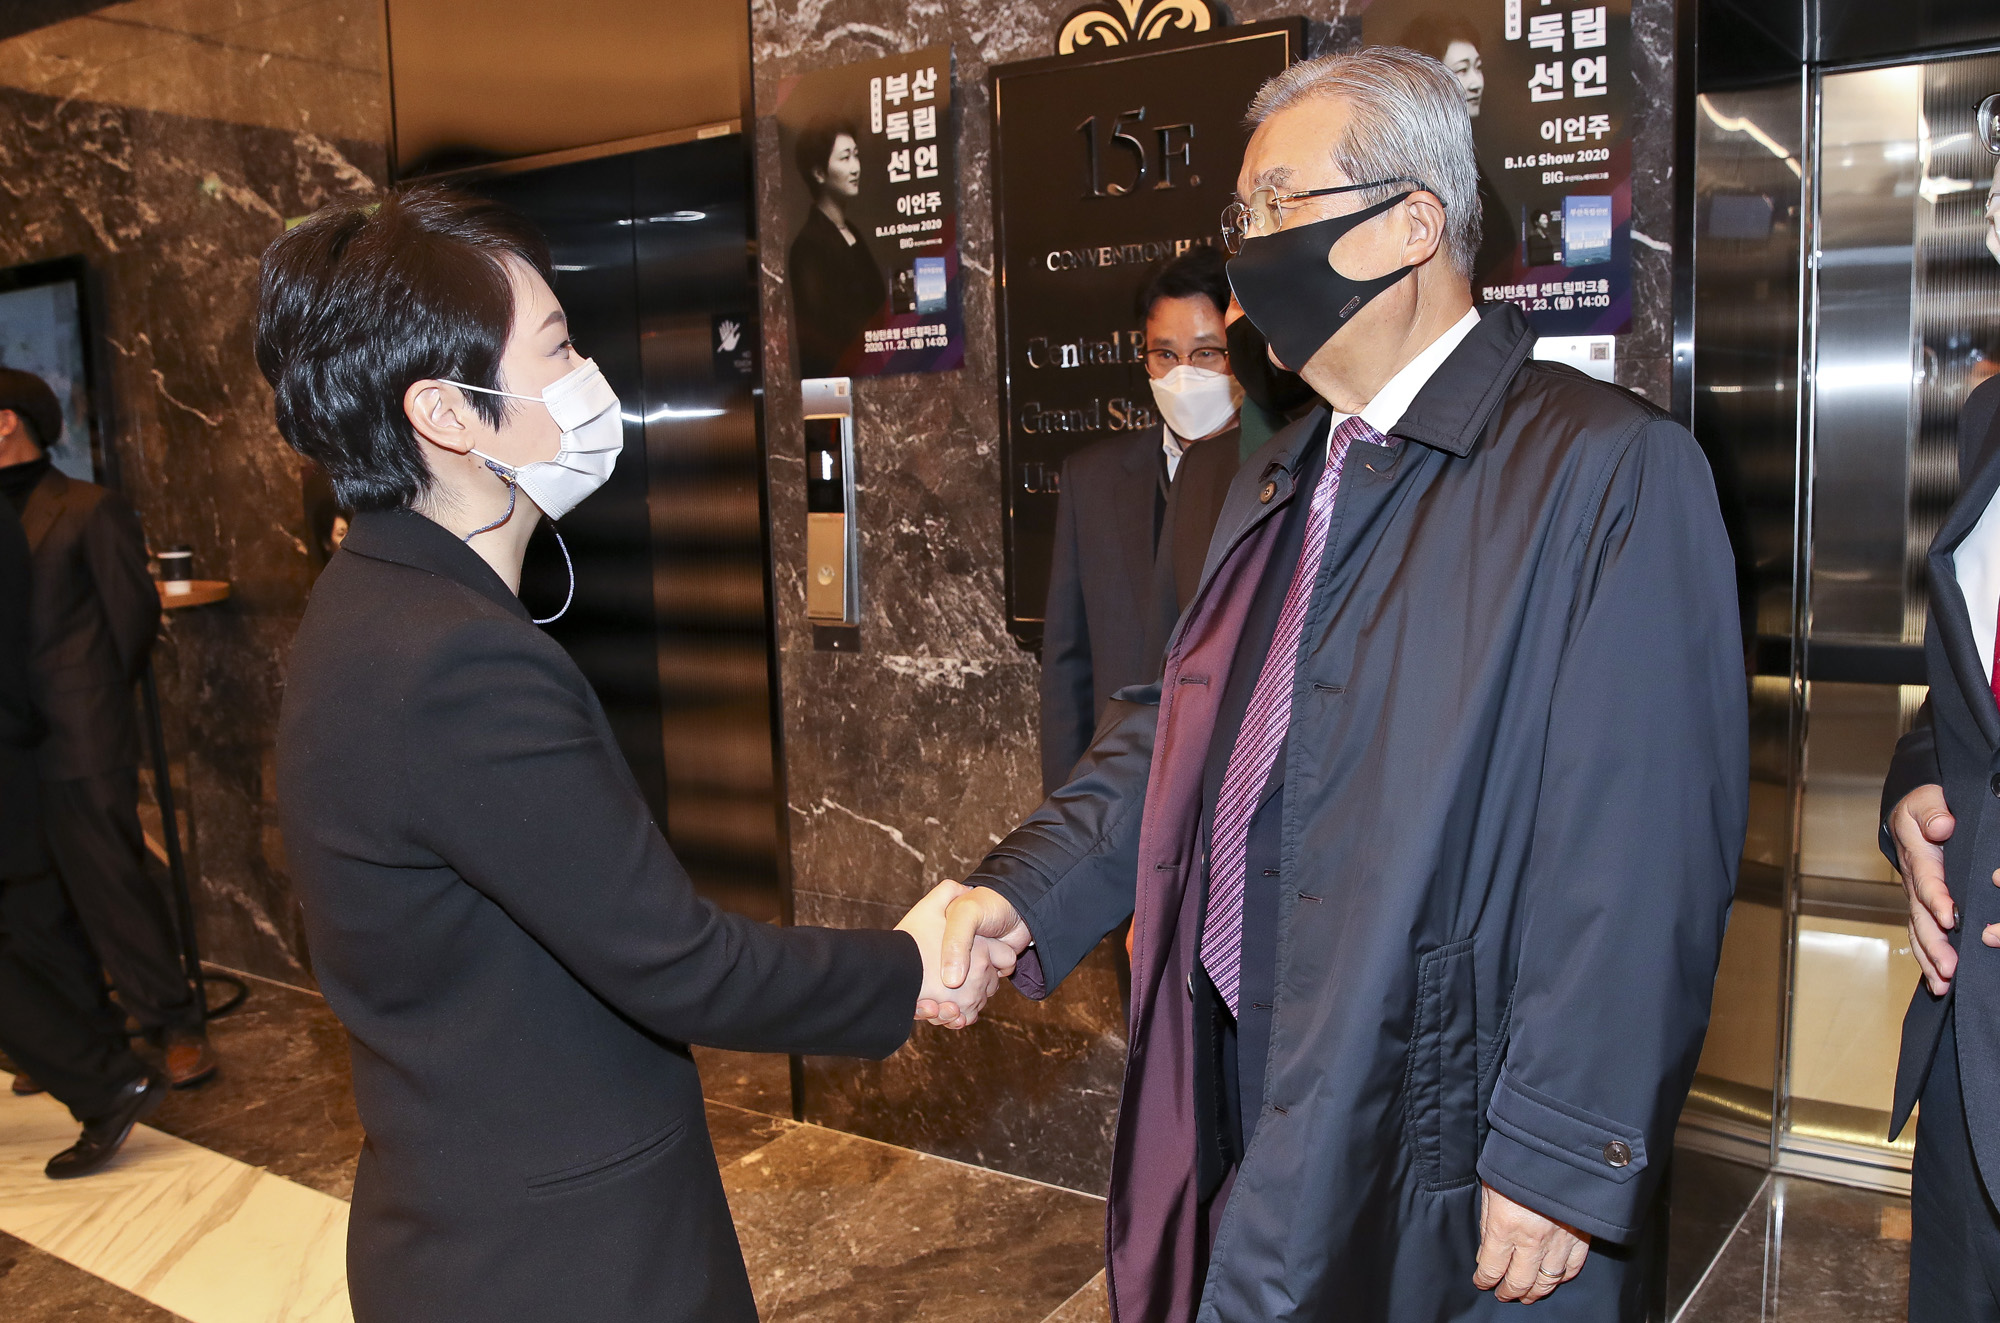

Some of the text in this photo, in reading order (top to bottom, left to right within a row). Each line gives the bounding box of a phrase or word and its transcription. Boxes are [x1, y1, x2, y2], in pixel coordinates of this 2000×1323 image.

[1527, 6, 1607, 53] 독립
[885, 66, 938, 106] 부산
[1527, 55, 1608, 103] 선언
[885, 105, 937, 143] 독립
[1540, 114, 1611, 144] 이언주
[887, 144, 939, 183] 선언
[1504, 147, 1610, 170] B.I.G Show 2020
[1542, 170, 1564, 185] BIG
[896, 191, 942, 217] 이언주
[896, 223, 920, 235] Show
[920, 218, 943, 232] 2020
[1046, 239, 1173, 272] CONVENTION
[1553, 296, 1574, 311] (월)
[1577, 294, 1610, 308] 14:00
[1027, 330, 1122, 369] Central
[1020, 398, 1102, 434] Grand
